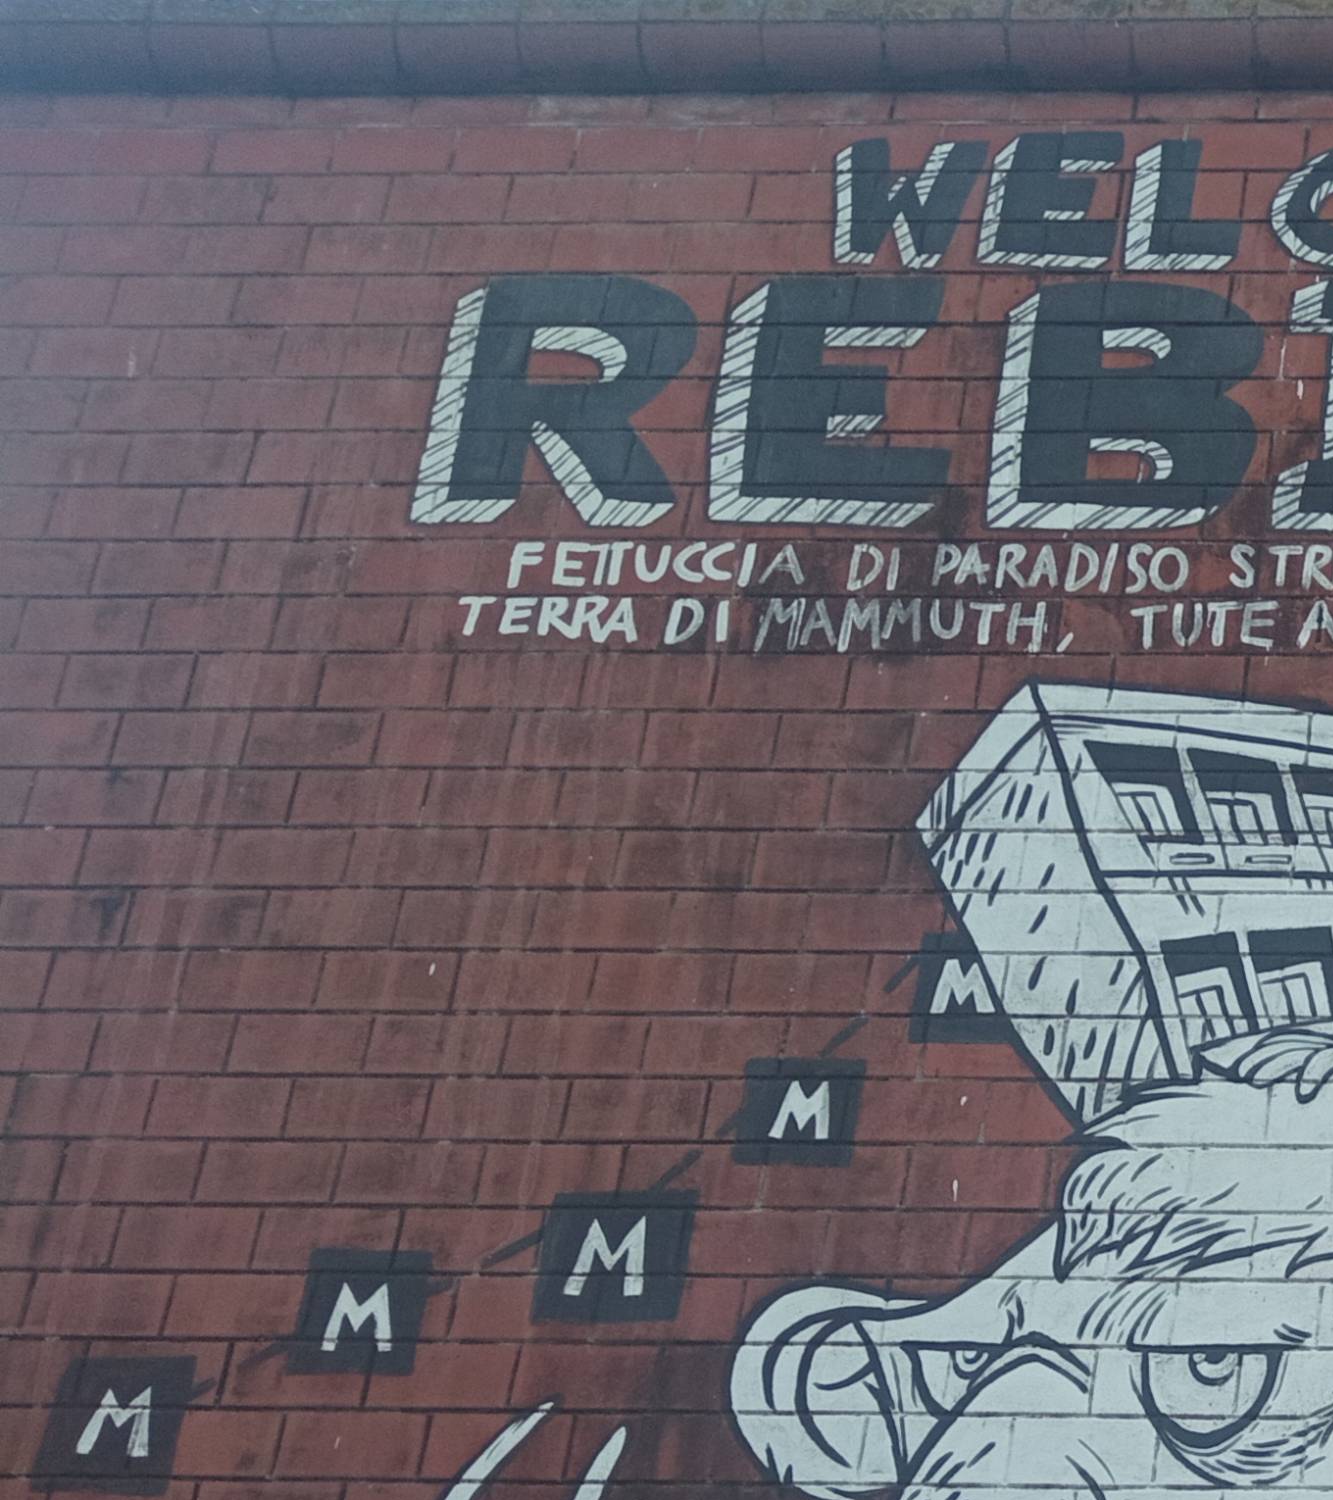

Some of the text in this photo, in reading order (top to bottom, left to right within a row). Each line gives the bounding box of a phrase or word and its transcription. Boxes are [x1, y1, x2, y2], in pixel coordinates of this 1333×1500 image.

[506, 541, 804, 588] FETTUCCIA
[846, 542, 899, 592] DI
[931, 542, 1190, 593] PARADISO
[458, 596, 638, 643] TERRA
[663, 598, 729, 644] DI
[753, 596, 1074, 654] MAMMUTH,
[1129, 600, 1281, 650] TUTE
[928, 958, 996, 1014] M
[767, 1079, 831, 1140] M
[562, 1215, 646, 1297] M
[320, 1281, 392, 1353] M
[75, 1386, 152, 1458] M
